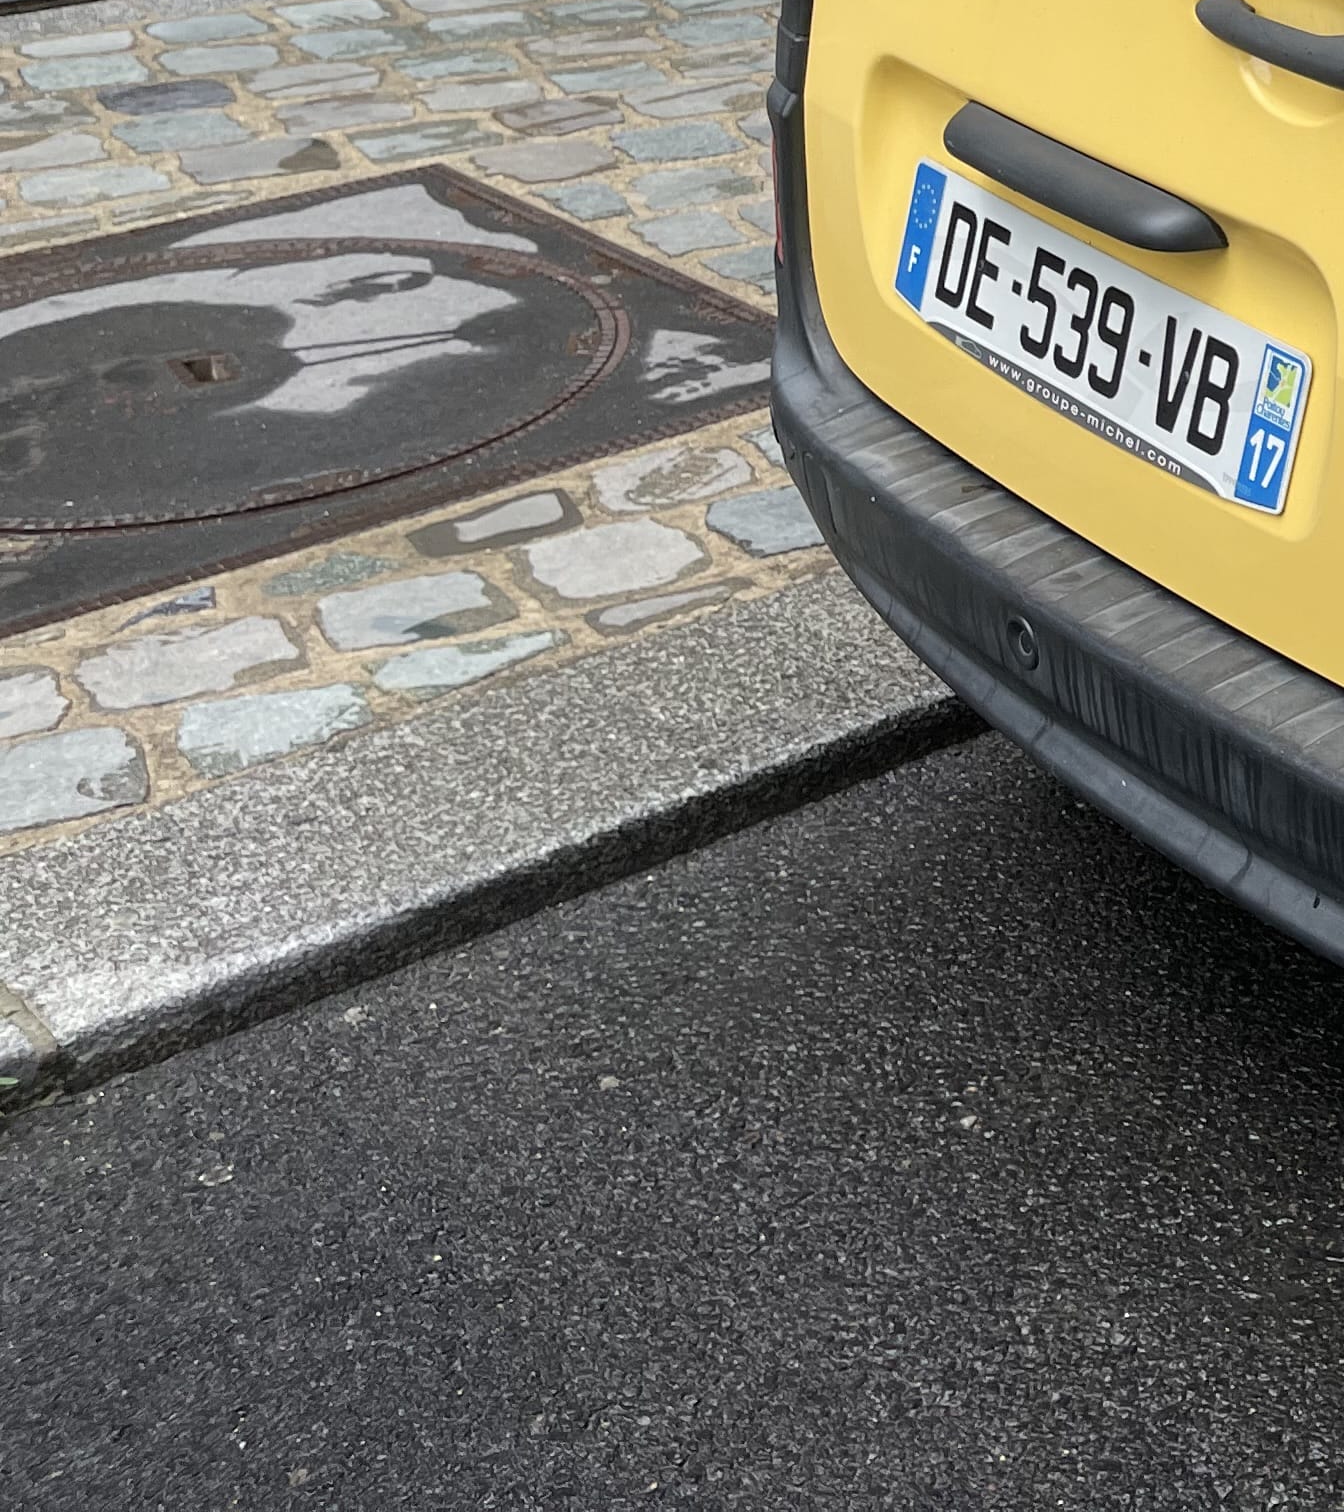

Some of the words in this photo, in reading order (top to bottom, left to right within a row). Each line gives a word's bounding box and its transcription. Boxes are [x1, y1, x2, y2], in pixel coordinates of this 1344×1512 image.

[907, 245, 921, 273] F
[935, 201, 1240, 457] DE-539-VB
[988, 354, 1182, 475] www.groupe-michel.com
[1248, 428, 1286, 489] 17
